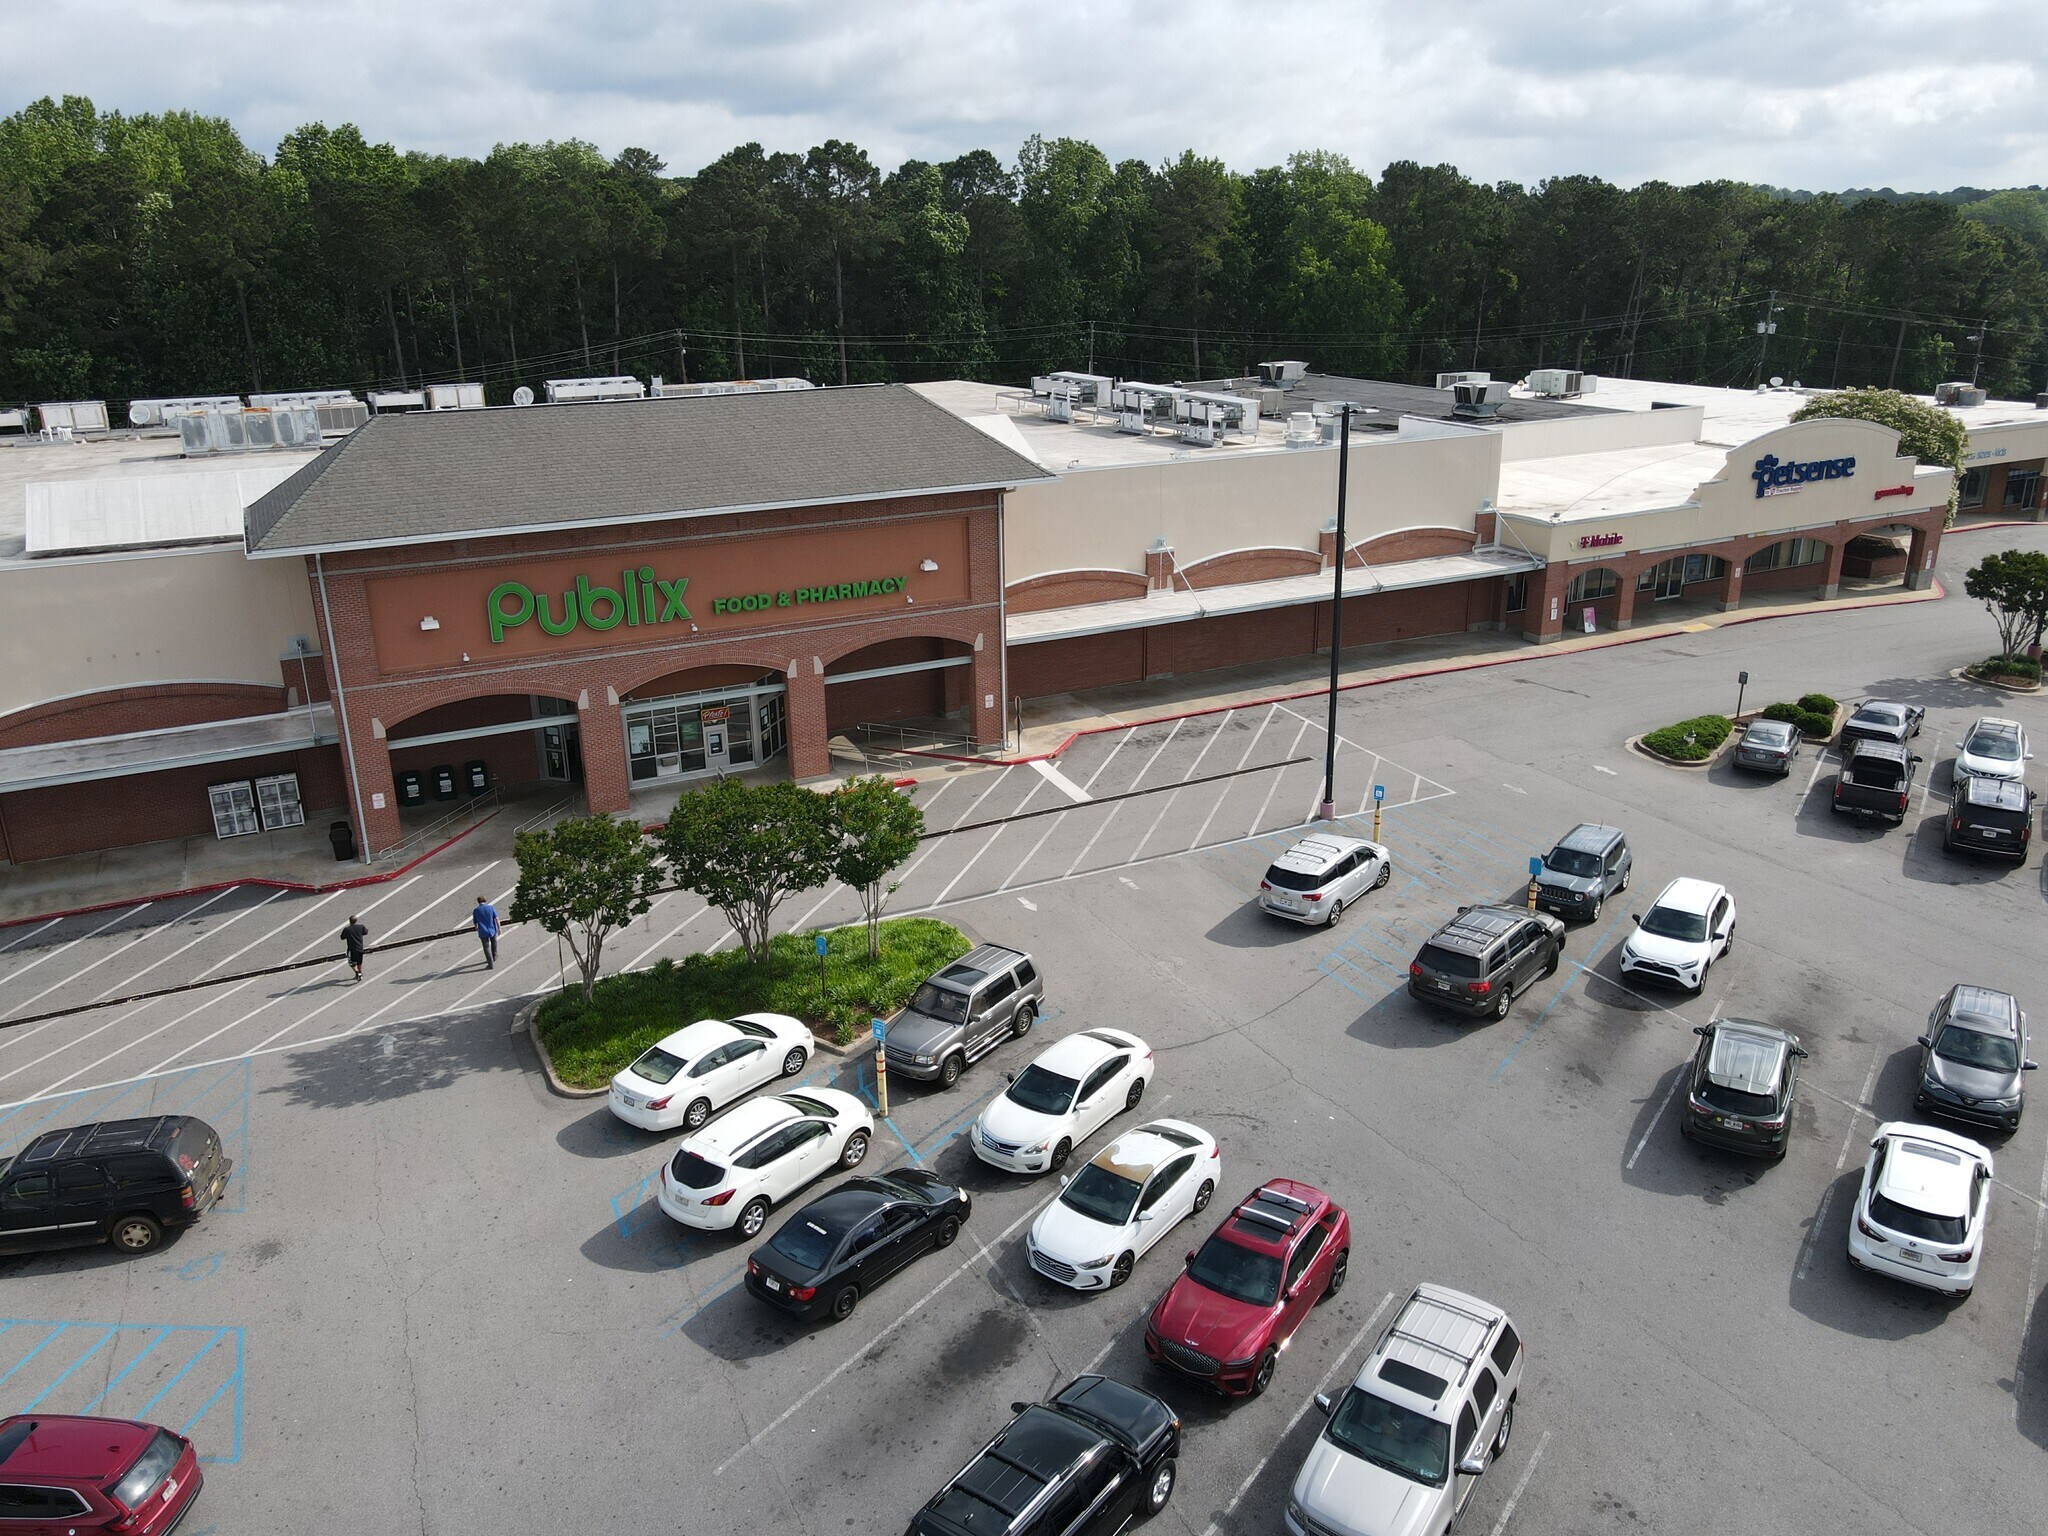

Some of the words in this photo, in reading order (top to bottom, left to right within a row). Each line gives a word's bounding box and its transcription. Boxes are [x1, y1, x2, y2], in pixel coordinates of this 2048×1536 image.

[1753, 455, 1856, 498] petsense
[487, 566, 693, 643] Publix
[713, 593, 773, 616] FOOD
[777, 589, 791, 608] &
[796, 575, 908, 606] PHARMACY
